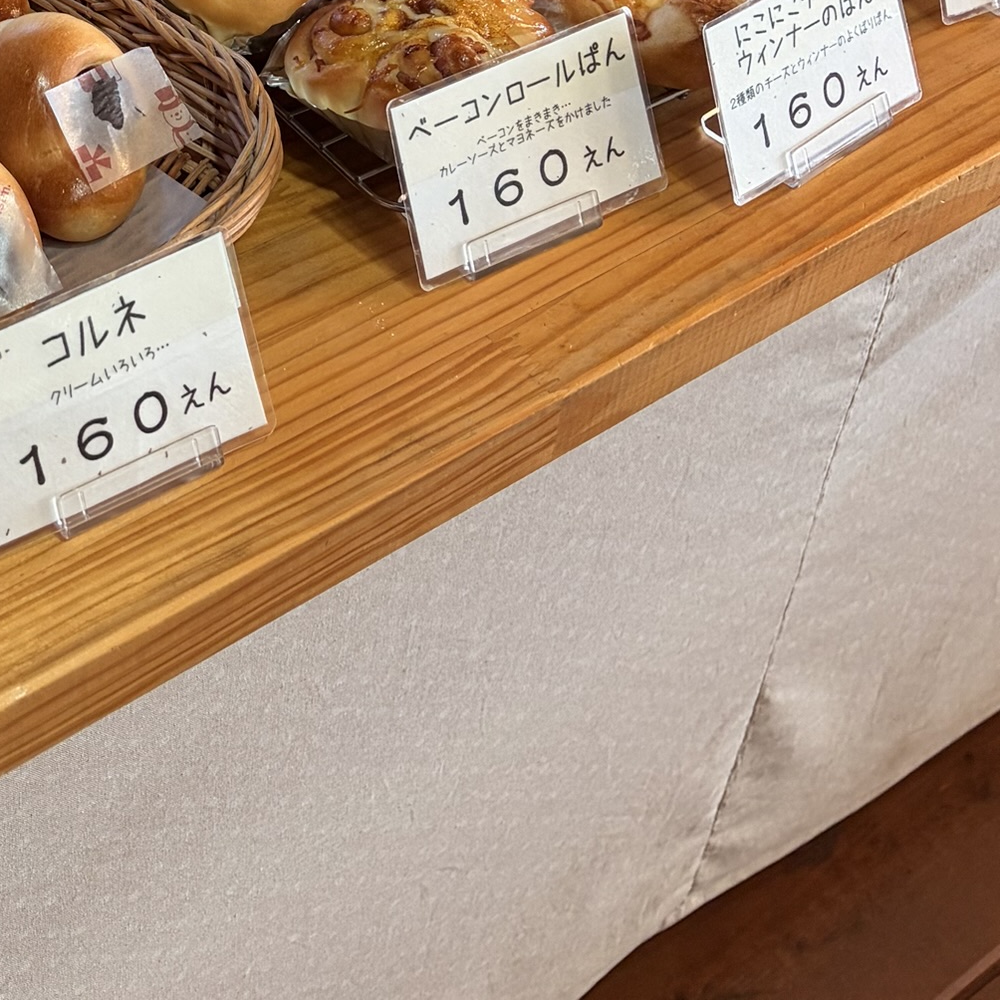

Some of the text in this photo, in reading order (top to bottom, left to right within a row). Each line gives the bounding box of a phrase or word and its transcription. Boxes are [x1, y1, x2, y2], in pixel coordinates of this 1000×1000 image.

[408, 37, 625, 141] ベーコンロールぱん
[753, 56, 888, 148] 160えん
[439, 96, 612, 178] カレーソースとマヨネーズをかけました
[448, 136, 625, 226] 160えん
[42, 295, 146, 368] コルネ
[19, 371, 231, 485] 160えん
